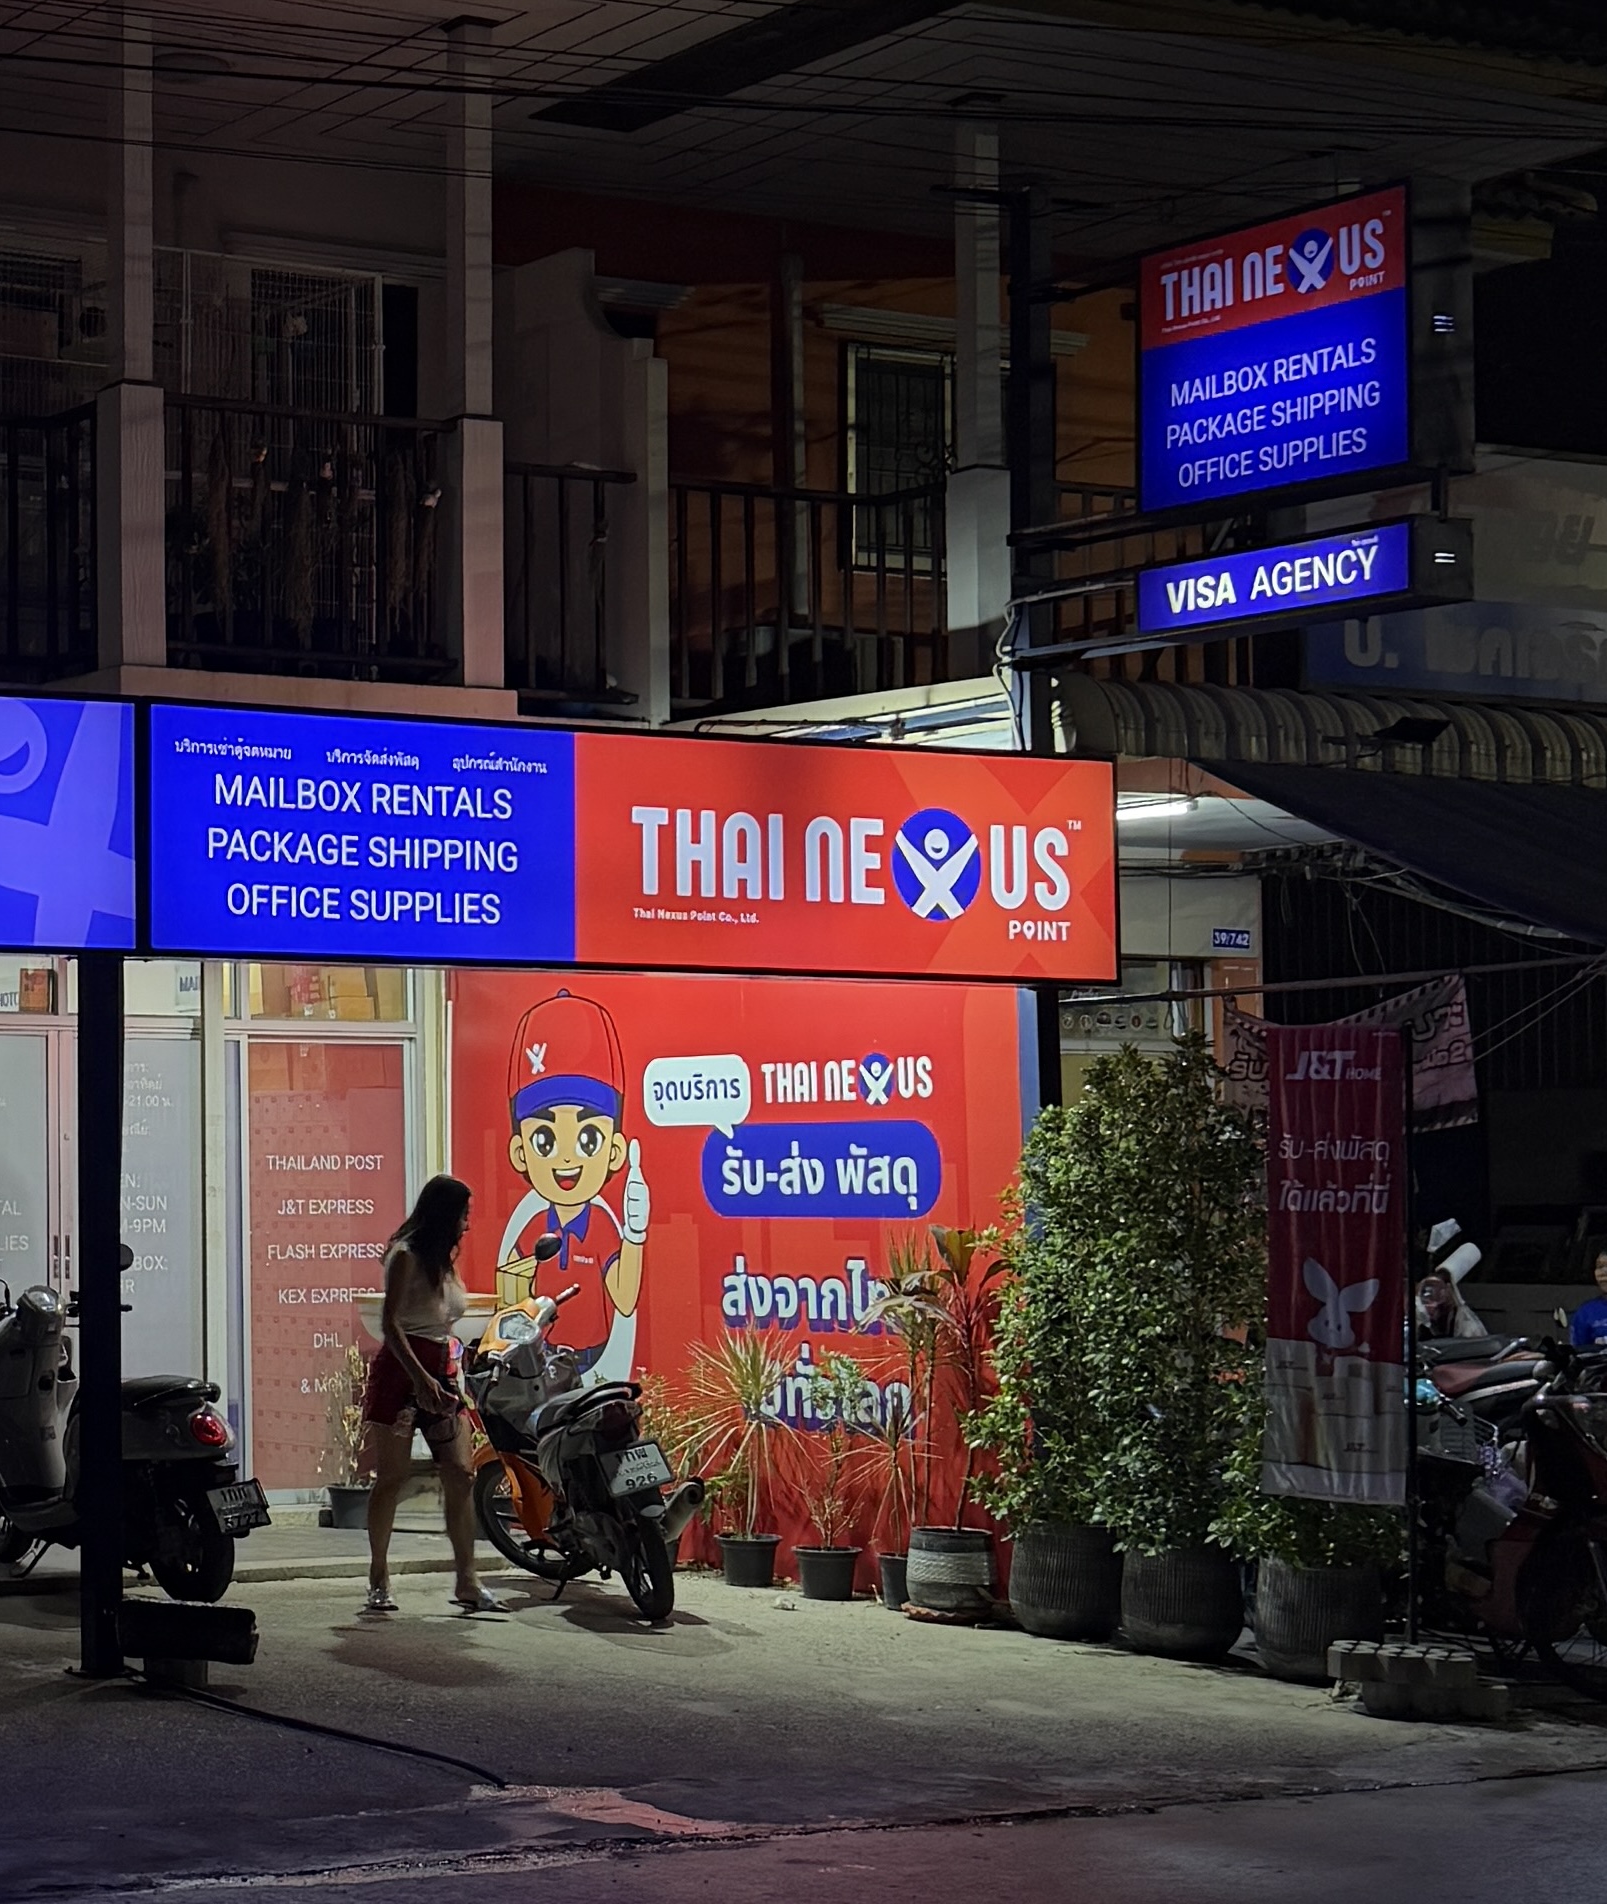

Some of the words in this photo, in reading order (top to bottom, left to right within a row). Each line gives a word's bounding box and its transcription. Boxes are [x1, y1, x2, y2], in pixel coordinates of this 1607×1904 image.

[1160, 256, 1235, 322] THAI
[1349, 270, 1386, 292] POINT
[1170, 362, 1268, 408] MAILBOX
[1273, 337, 1376, 386] RENTALS
[1166, 405, 1266, 449] PACKAGE
[1271, 381, 1382, 428] SHIPPING
[1178, 450, 1254, 488] OFFICE
[1258, 428, 1368, 472] SUPPLIES
[1166, 571, 1236, 615] VISA
[1250, 545, 1378, 601] AGENCY
[214, 773, 362, 814] MAILBOX
[371, 783, 513, 820] RENTALS
[207, 827, 360, 867] PACKAGE
[367, 836, 519, 873] SHIPPING
[631, 805, 785, 900] THAI
[805, 807, 1071, 922] NEXUS
[227, 883, 340, 921] OFFICE
[349, 889, 501, 925] SUPPLIES
[1008, 920, 1071, 942] POINT
[761, 1061, 818, 1104] THAI
[824, 1053, 933, 1106] NEXUS
[1284, 1049, 1357, 1081] J&T
[1345, 1067, 1382, 1081] HOME
[652, 1073, 741, 1111] จุดบริการ
[266, 1155, 341, 1171] THAILAND
[345, 1155, 384, 1170] POST
[722, 1140, 825, 1195] รับ-ส่ง
[836, 1143, 918, 1211] พัสดุ
[278, 1199, 305, 1215] J&T
[309, 1199, 374, 1214] EXPRESS
[267, 1244, 315, 1260] FLASH
[320, 1243, 385, 1259] EXPRESS
[278, 1289, 306, 1304] KEX
[313, 1332, 343, 1348] DHL
[301, 1378, 311, 1393] &
[626, 1473, 657, 1490] 926
